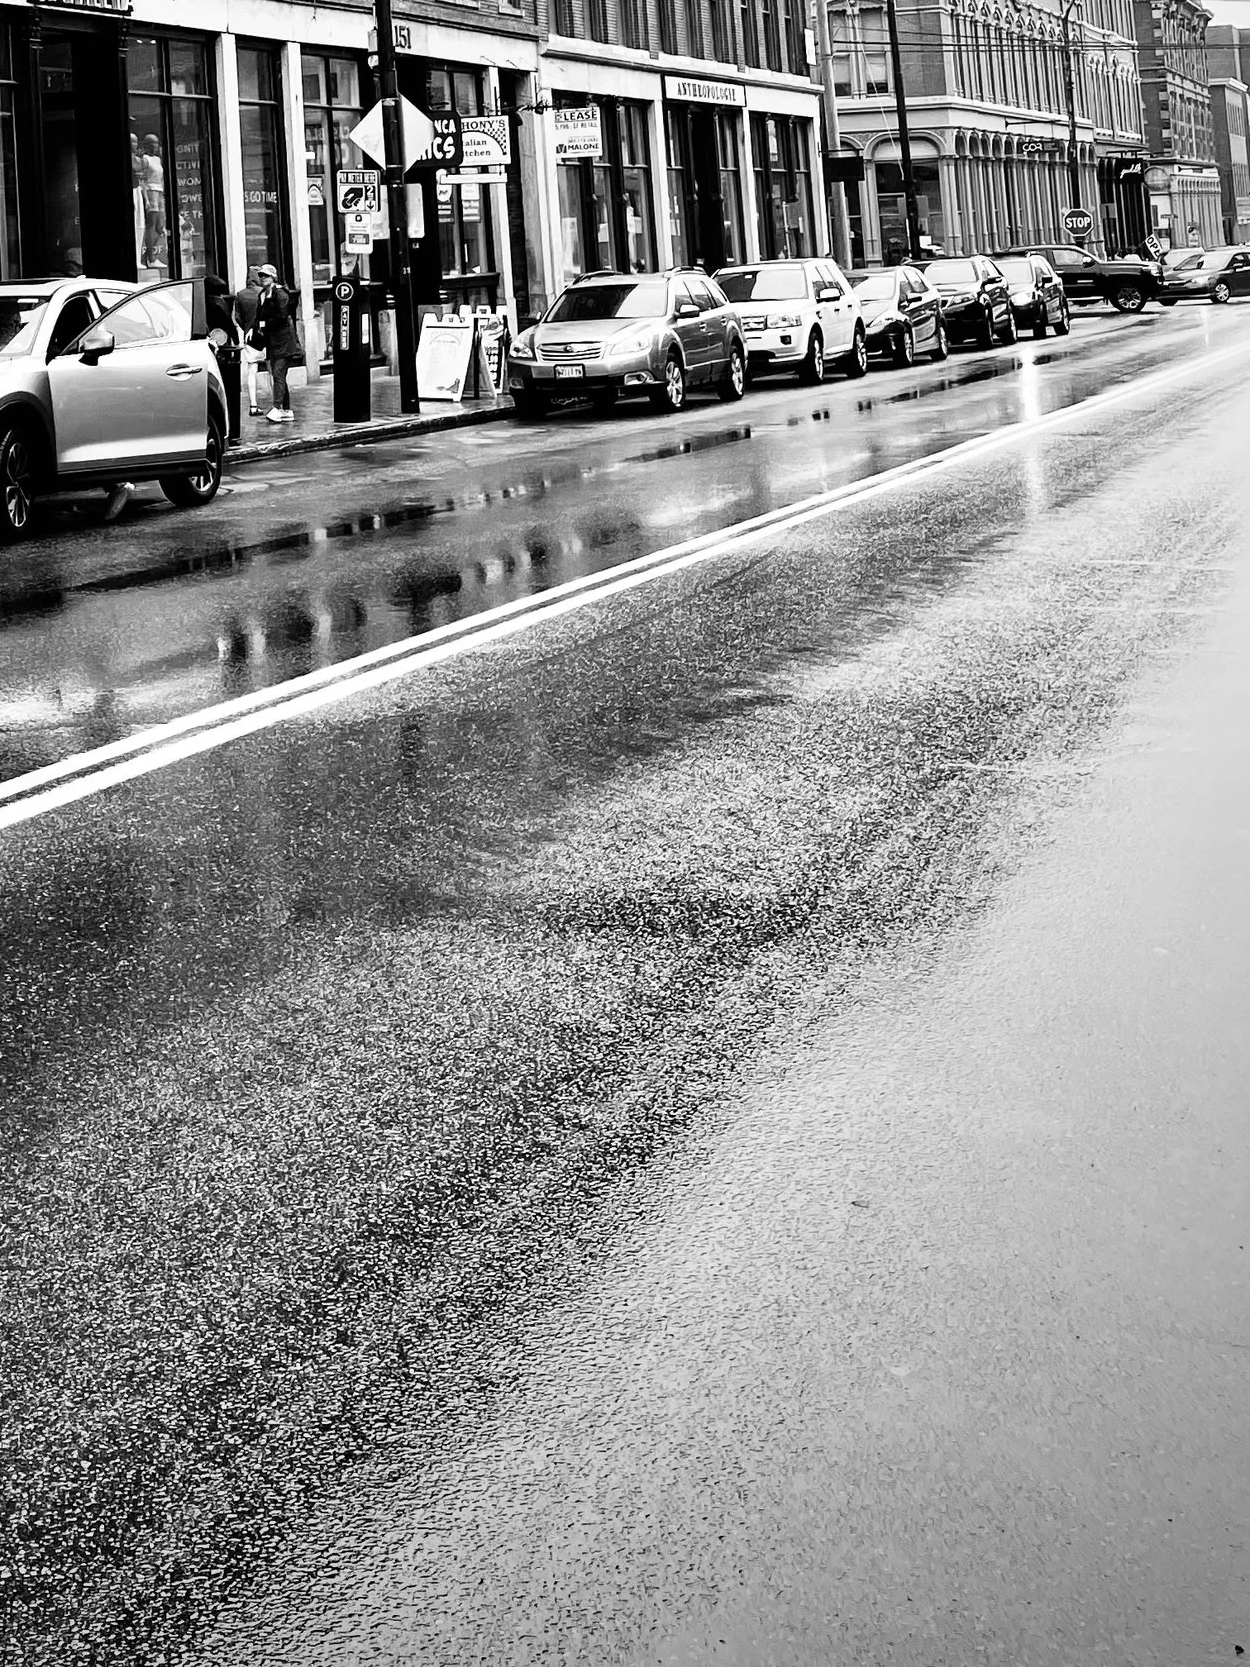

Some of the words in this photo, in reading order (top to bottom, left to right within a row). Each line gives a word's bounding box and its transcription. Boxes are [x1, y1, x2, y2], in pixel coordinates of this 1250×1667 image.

[394, 26, 412, 49] 151
[250, 191, 261, 203] GO
[1066, 217, 1091, 228] STOP
[341, 286, 350, 297] P
